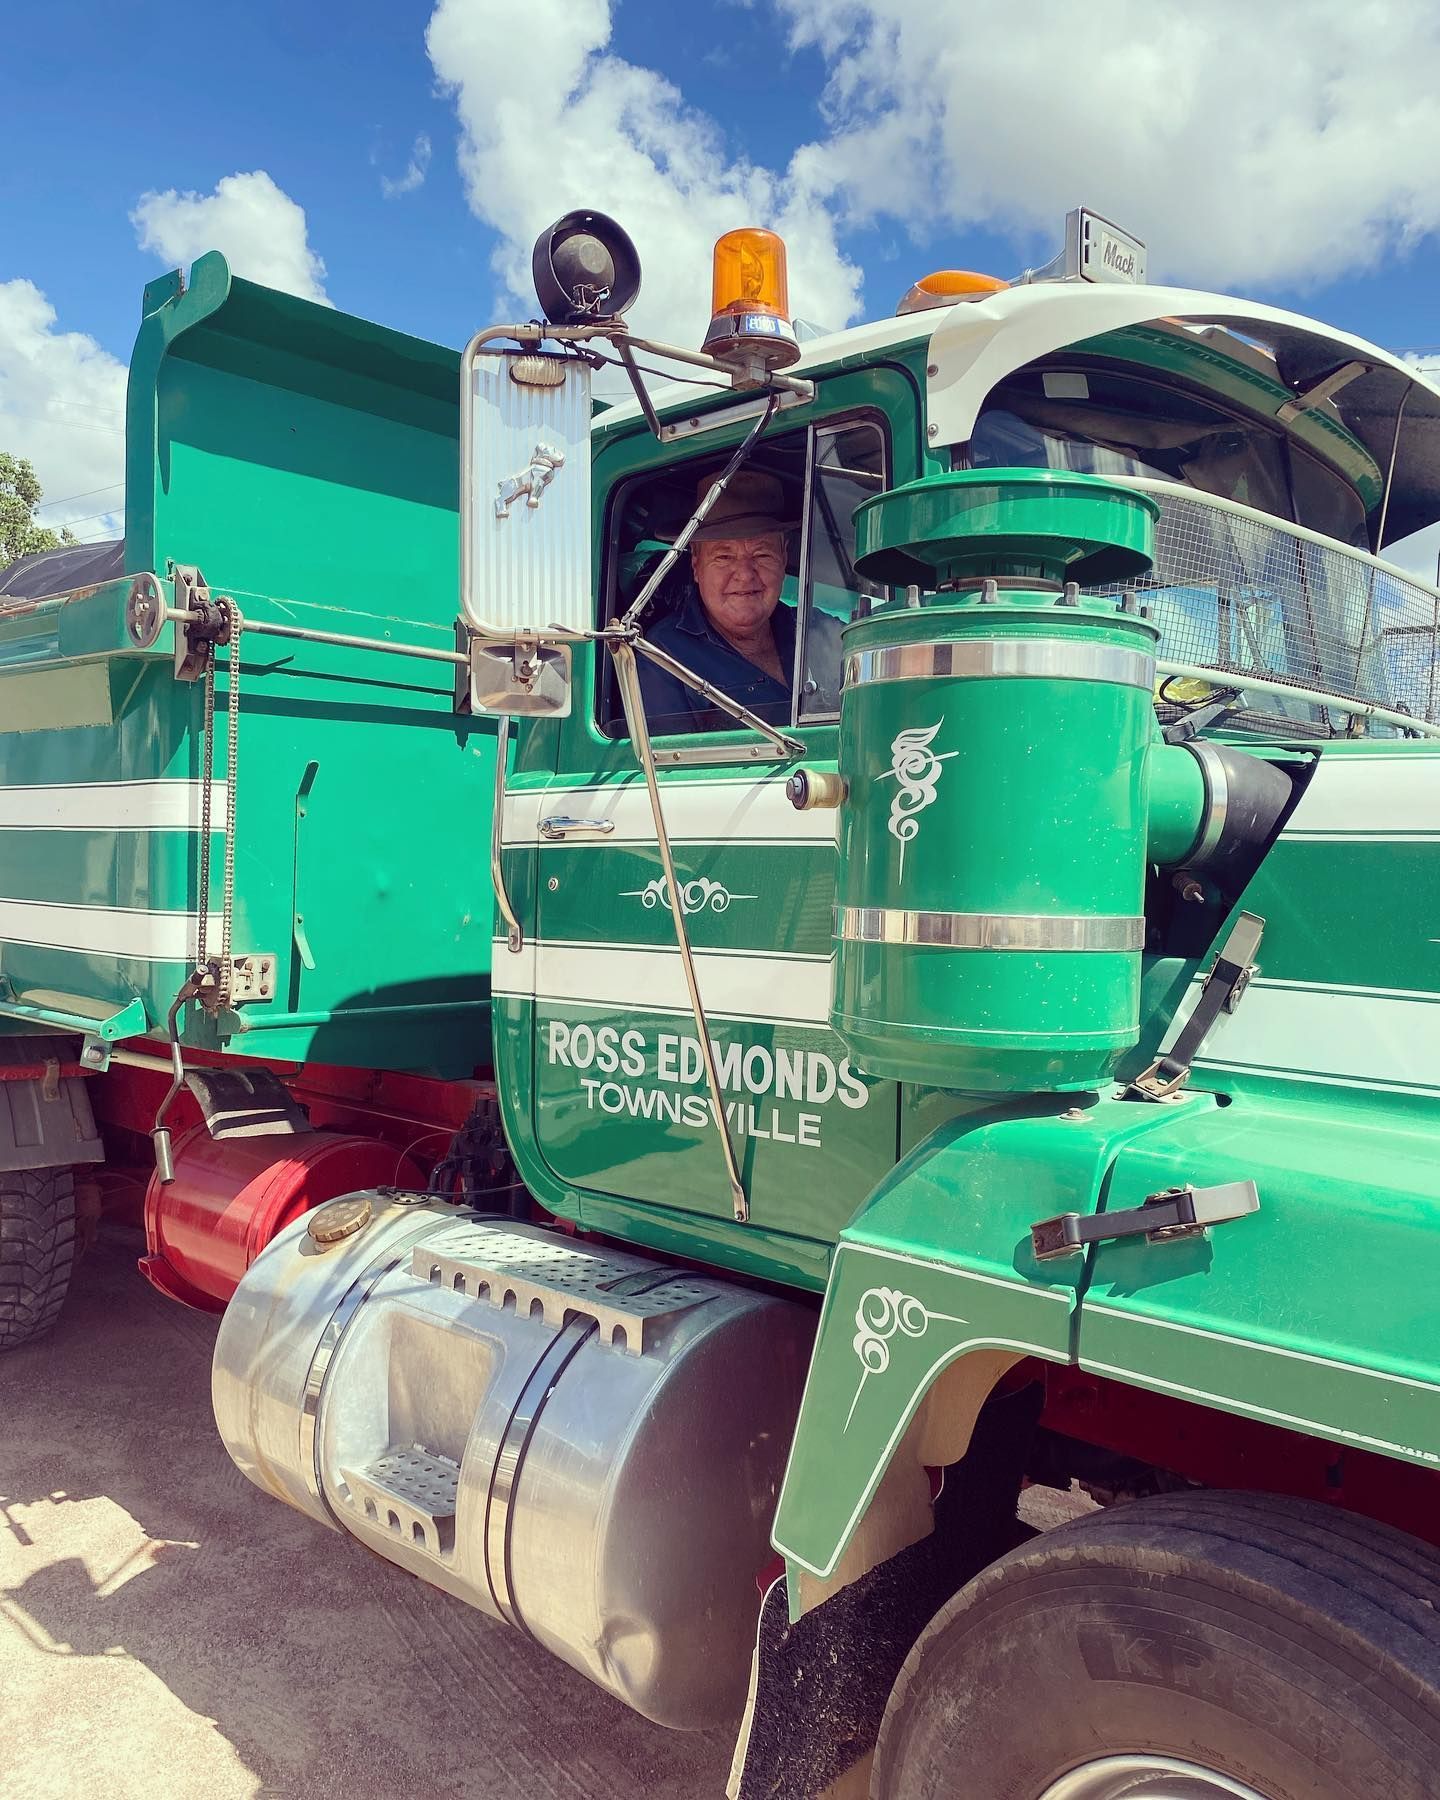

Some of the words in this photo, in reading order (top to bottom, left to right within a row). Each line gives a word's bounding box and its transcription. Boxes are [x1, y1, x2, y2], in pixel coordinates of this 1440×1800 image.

[1103, 240, 1135, 275] Mack
[549, 1020, 646, 1077] ROSS
[657, 1033, 869, 1110] EDMONDS
[580, 1078, 822, 1148] TOWNSVILLE
